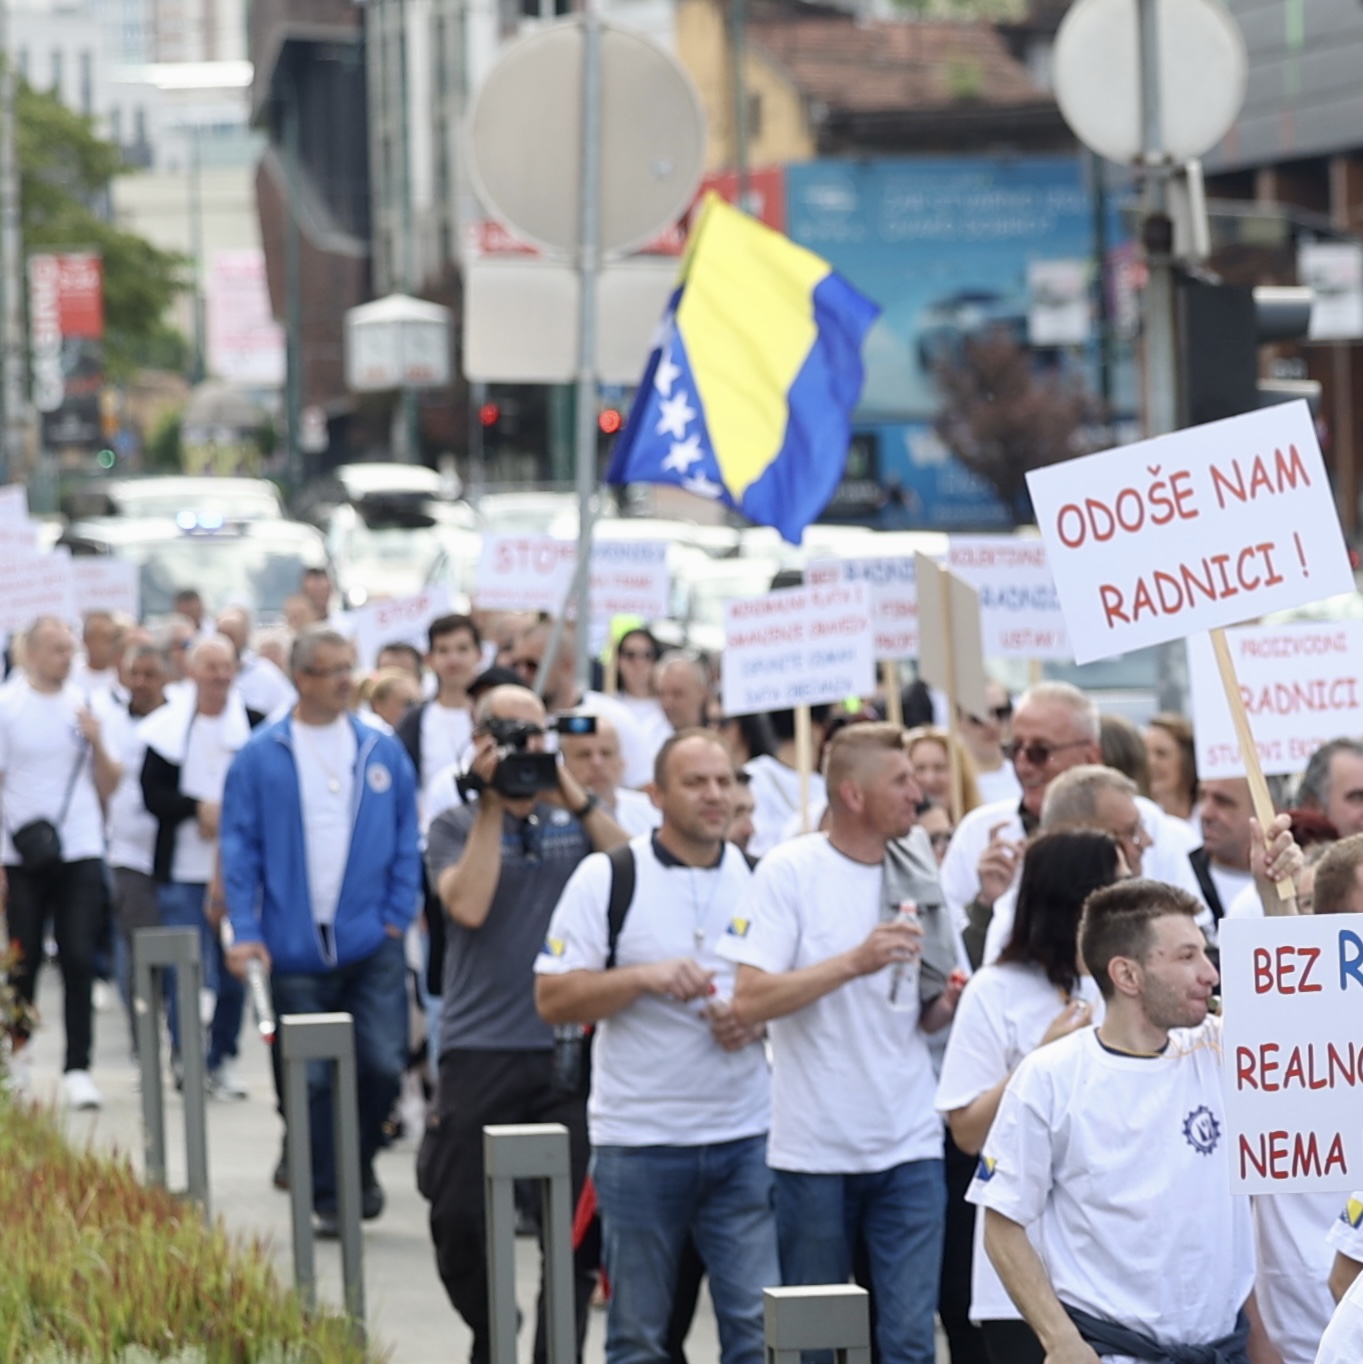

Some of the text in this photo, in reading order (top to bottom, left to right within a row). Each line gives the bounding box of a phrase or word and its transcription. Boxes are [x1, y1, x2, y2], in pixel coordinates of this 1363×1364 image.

[1057, 464, 1199, 548] ODOŠE
[1209, 444, 1311, 509] NAM
[1099, 531, 1310, 628] RADNICI !
[1238, 678, 1360, 715] RADNICI
[1253, 946, 1322, 994] BEZ
[1239, 1130, 1347, 1180] NEMA
